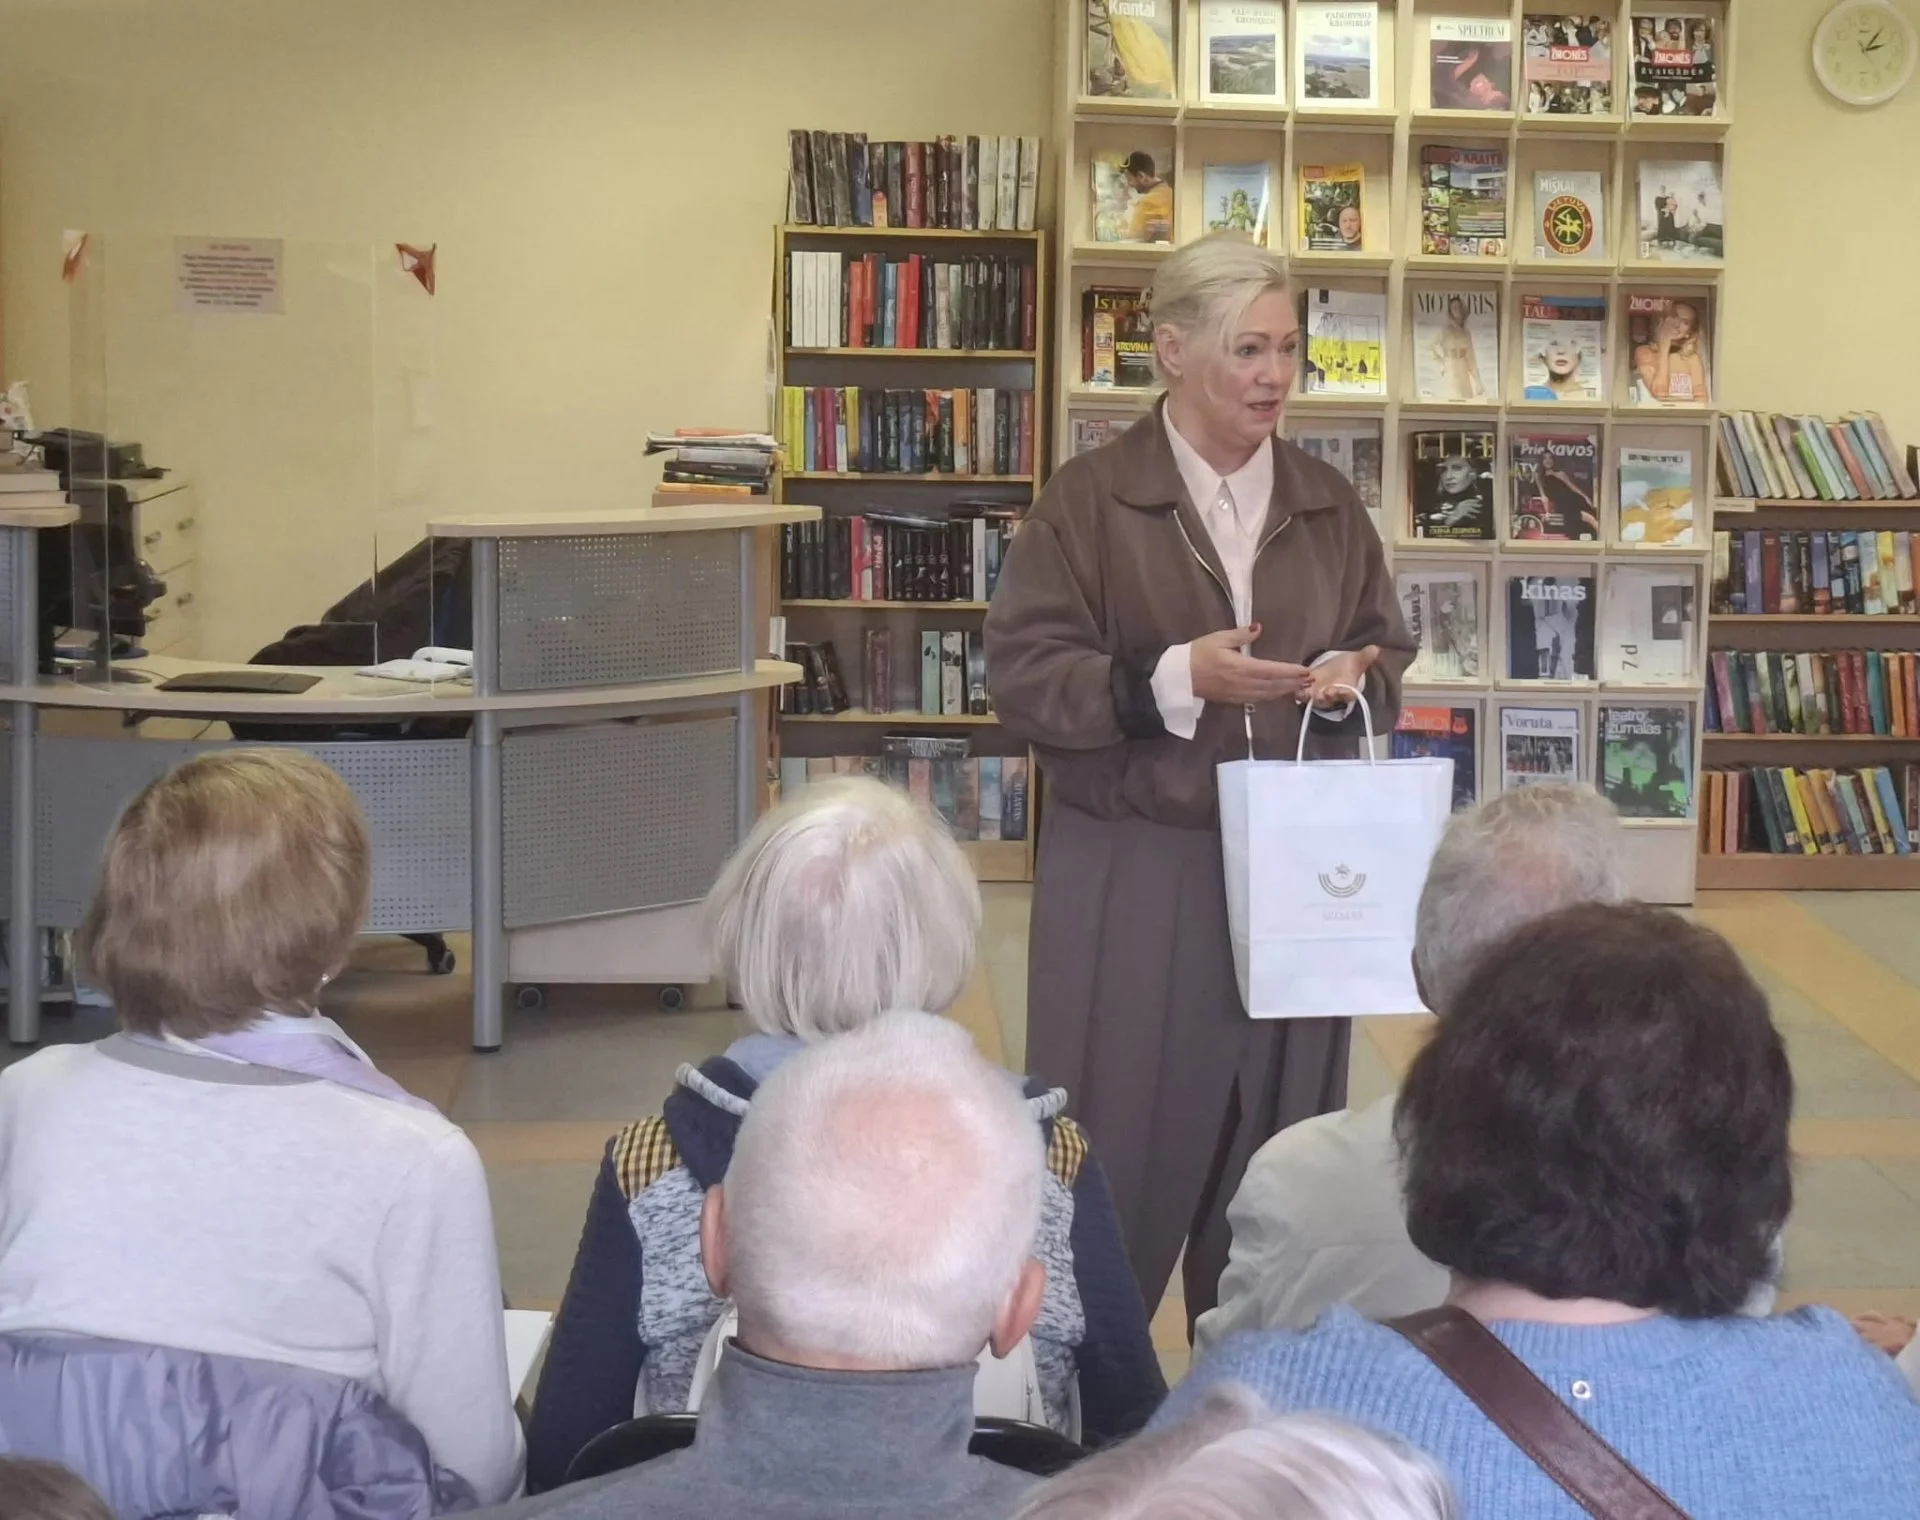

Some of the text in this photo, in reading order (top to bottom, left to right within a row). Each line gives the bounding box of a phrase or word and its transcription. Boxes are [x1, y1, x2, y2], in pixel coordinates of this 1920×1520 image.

[1109, 0, 1155, 17] Krantai
[1416, 432, 1493, 459] ELLE
[1547, 439, 1594, 457] kavos
[1520, 575, 1587, 601] kinas
[1504, 713, 1553, 729] Voruta
